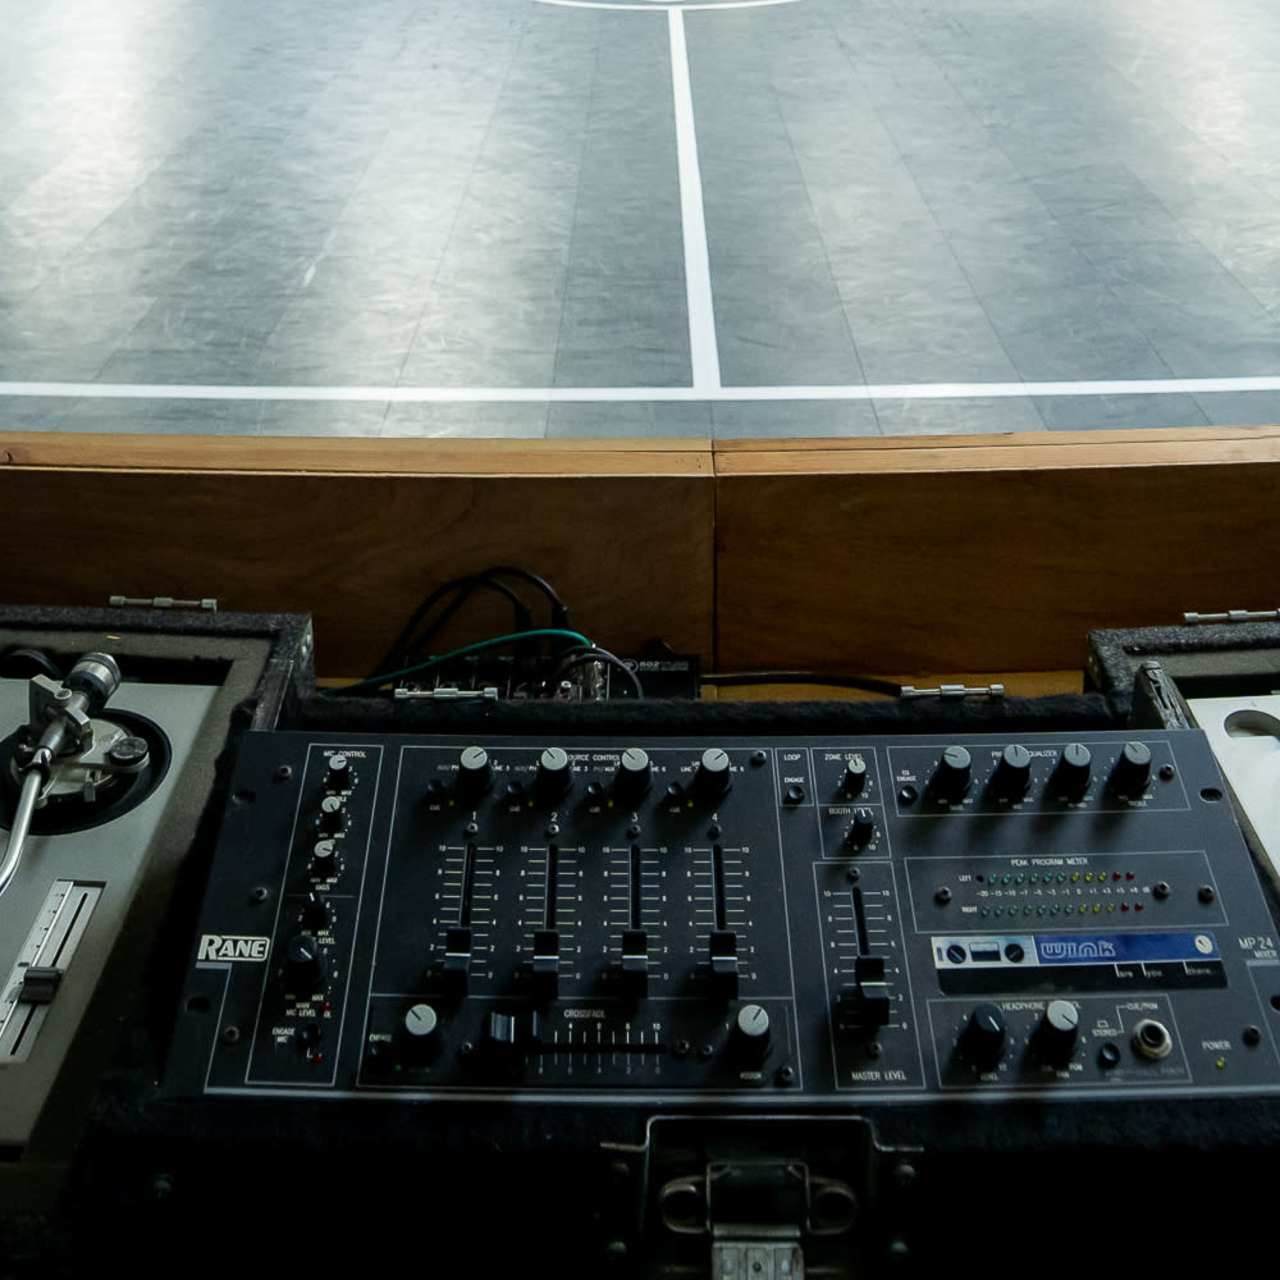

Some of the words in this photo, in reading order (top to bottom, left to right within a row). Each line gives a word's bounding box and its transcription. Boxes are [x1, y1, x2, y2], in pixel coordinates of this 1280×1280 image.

[784, 753, 801, 761] LOOP
[824, 753, 841, 761] ZONE
[828, 807, 851, 815] BOOTH
[551, 811, 558, 822] 2
[711, 812, 718, 822] 4
[197, 934, 268, 961] RANE
[1238, 936, 1256, 949] MP
[1257, 936, 1274, 949] 24
[1202, 1040, 1232, 1050] POWER
[851, 1071, 880, 1080] MASTER
[883, 1070, 906, 1080] LEVEL
